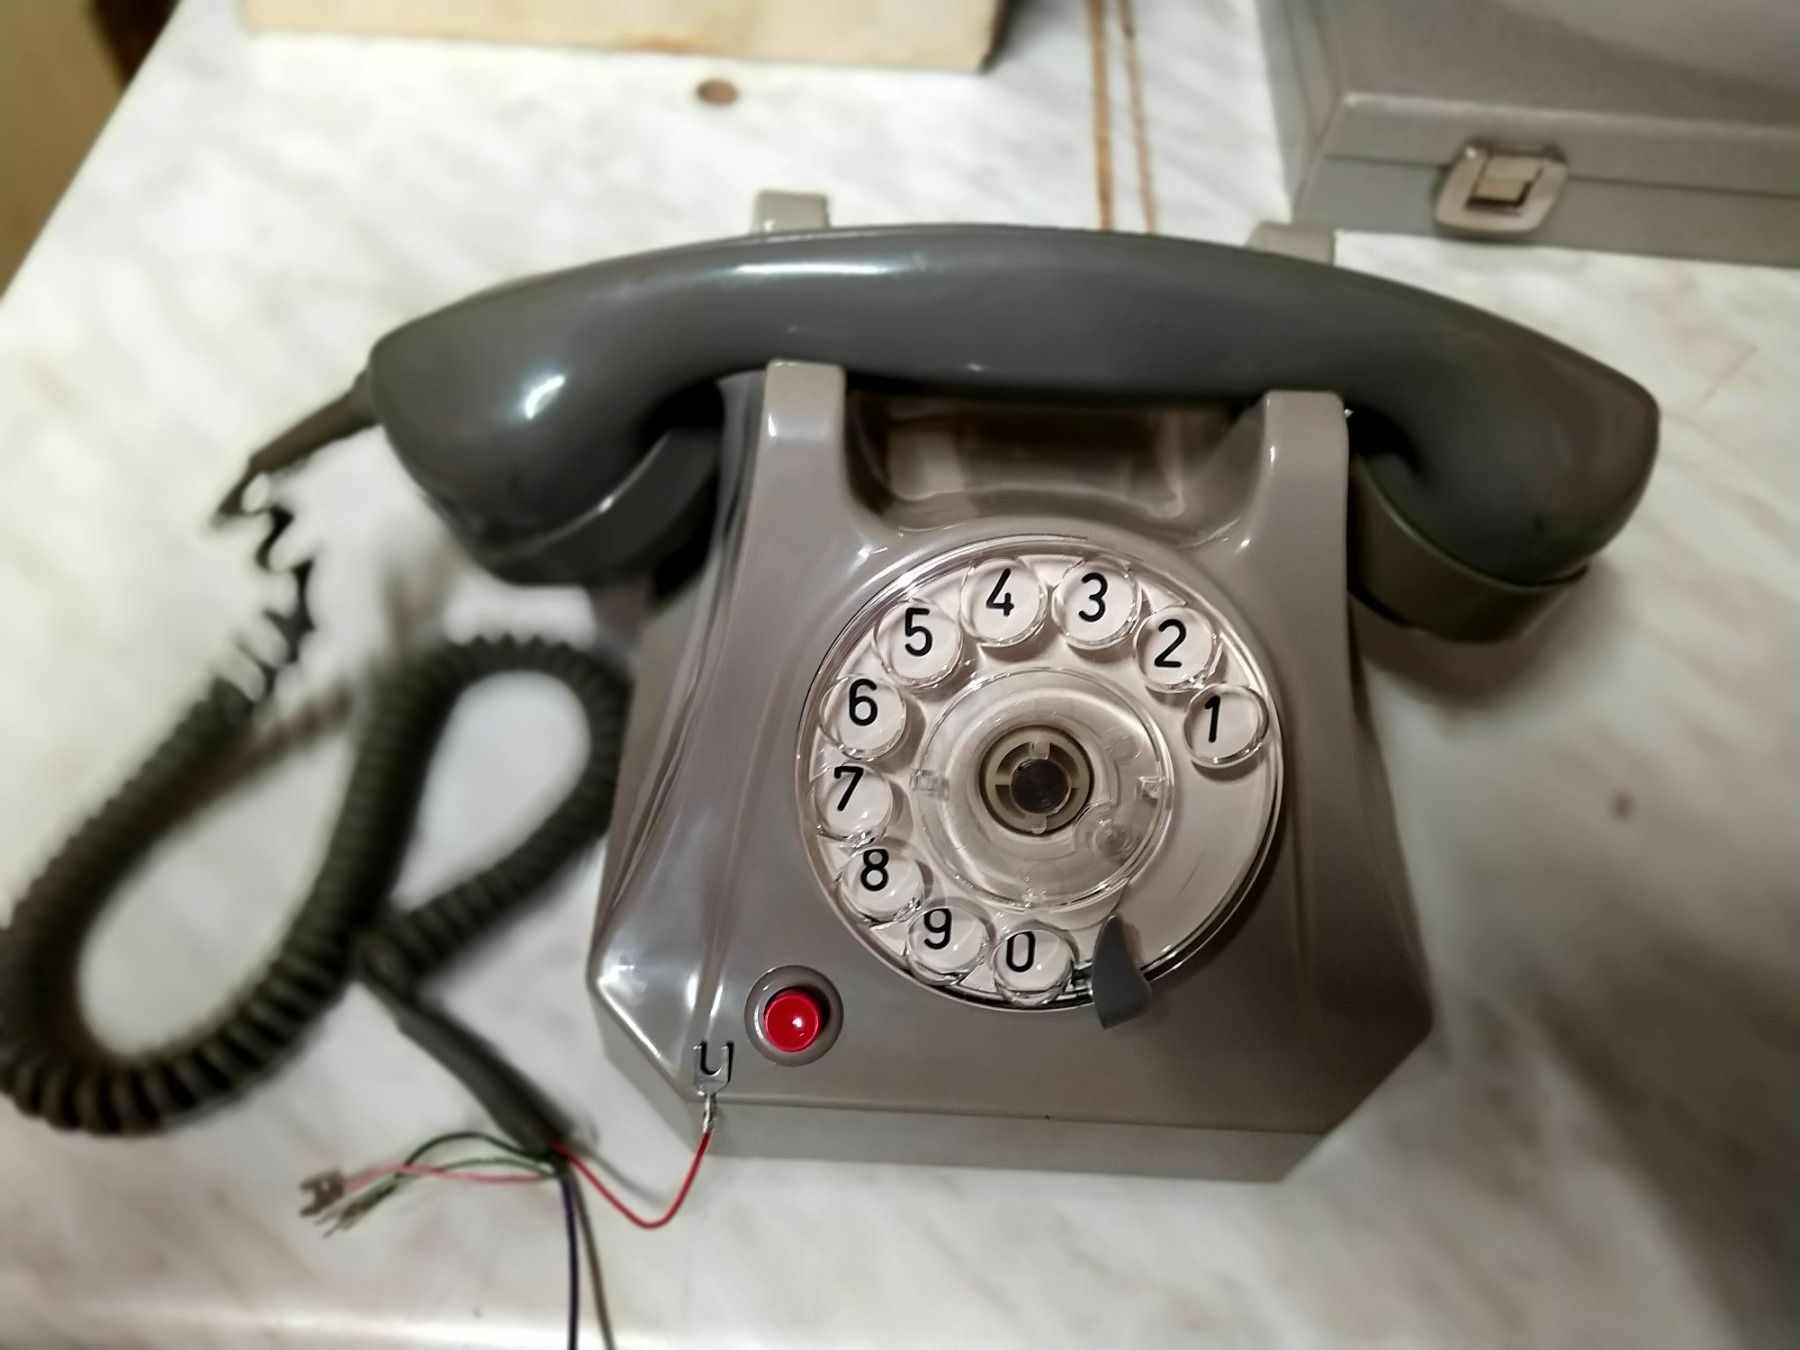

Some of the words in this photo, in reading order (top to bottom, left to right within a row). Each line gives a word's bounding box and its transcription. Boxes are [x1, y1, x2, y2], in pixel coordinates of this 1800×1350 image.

[986, 567, 1015, 616] 4
[1078, 572, 1108, 622] 3
[904, 607, 933, 657] 5
[1154, 618, 1187, 668] 2
[849, 678, 878, 727] 6
[1202, 694, 1221, 743] 1
[833, 765, 865, 812] 7
[860, 848, 890, 892] 8
[923, 908, 953, 950] 9
[1005, 930, 1036, 973] 0
